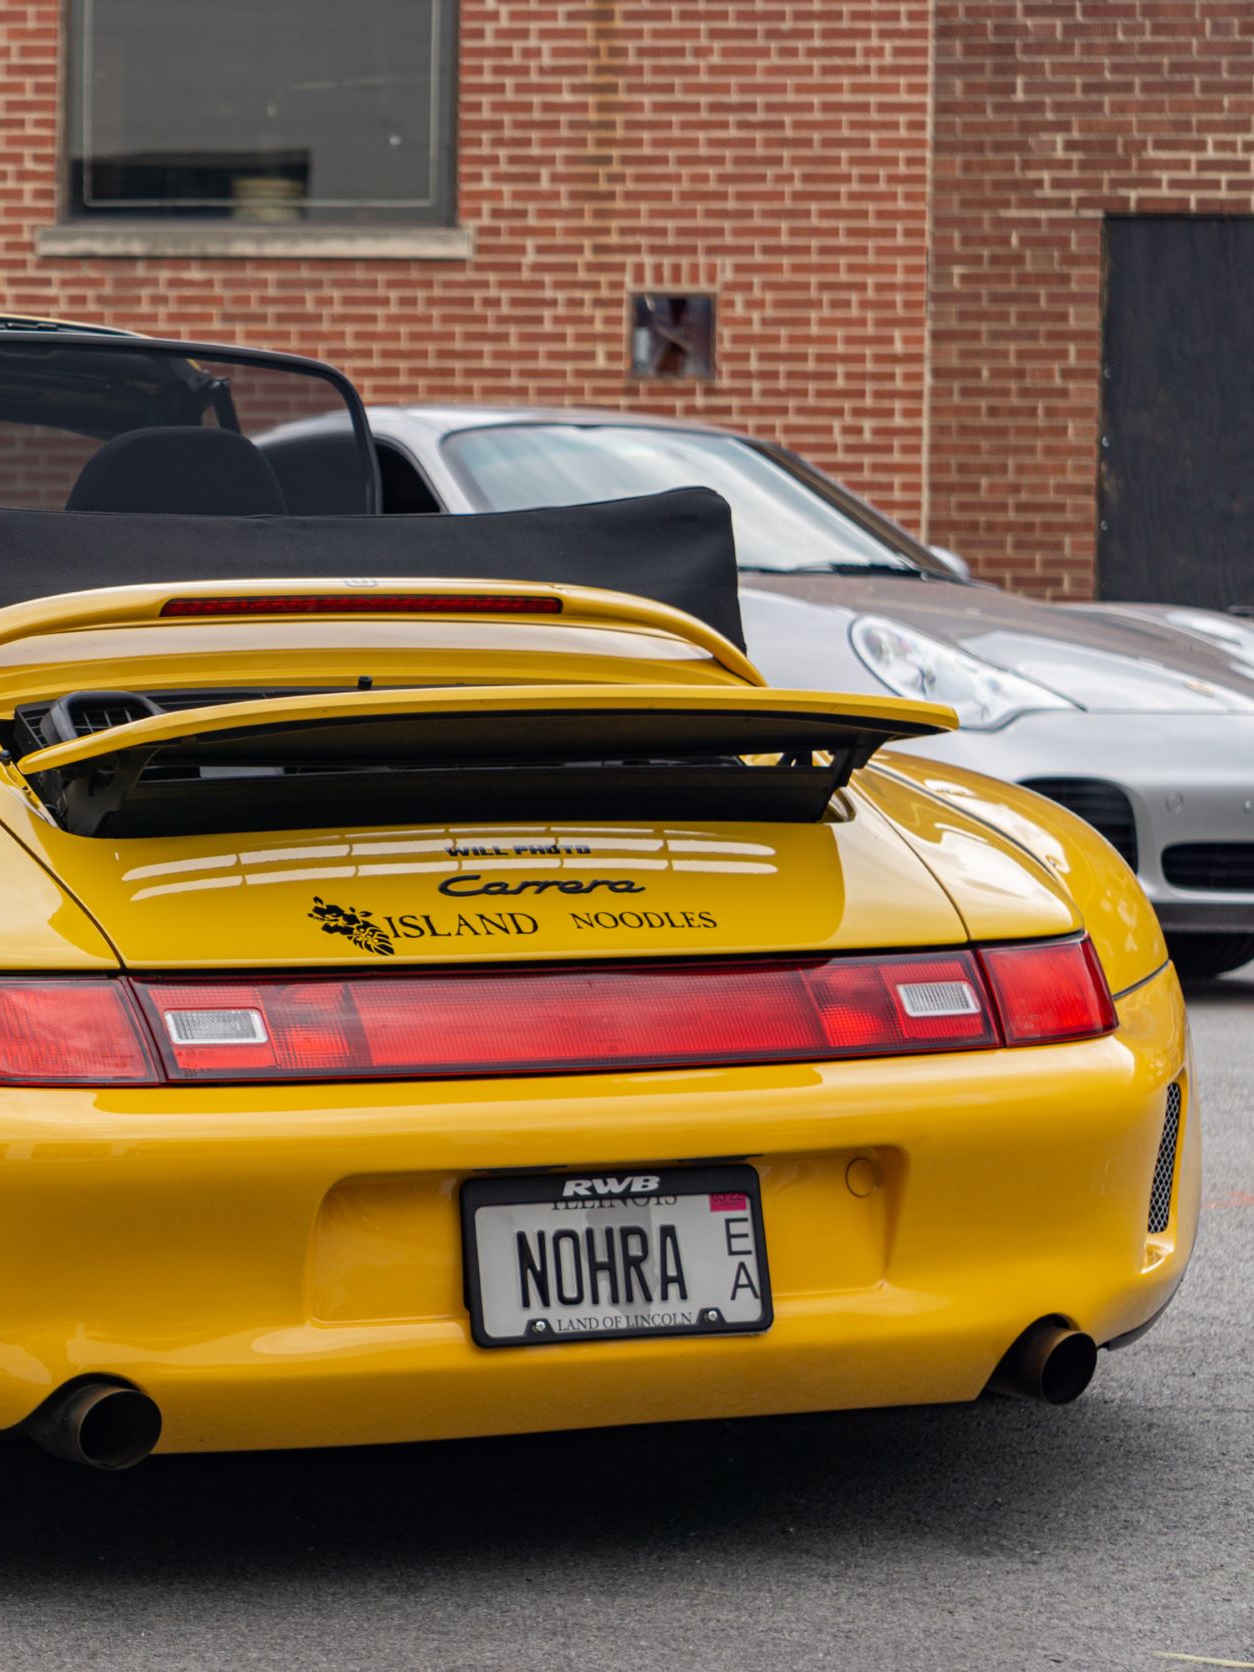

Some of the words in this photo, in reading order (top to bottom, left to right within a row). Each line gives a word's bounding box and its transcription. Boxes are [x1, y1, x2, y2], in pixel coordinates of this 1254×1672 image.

[444, 845, 508, 857] WILL
[513, 844, 592, 856] PHOTO
[438, 874, 646, 897] Carrera
[382, 911, 540, 939] ISLAND
[569, 910, 718, 930] NOODLES
[562, 1175, 660, 1197] RWB
[514, 1224, 689, 1309] NOHRA
[556, 1316, 600, 1332] LAND
[602, 1315, 623, 1329] OF
[626, 1312, 693, 1328] LINCOLN
